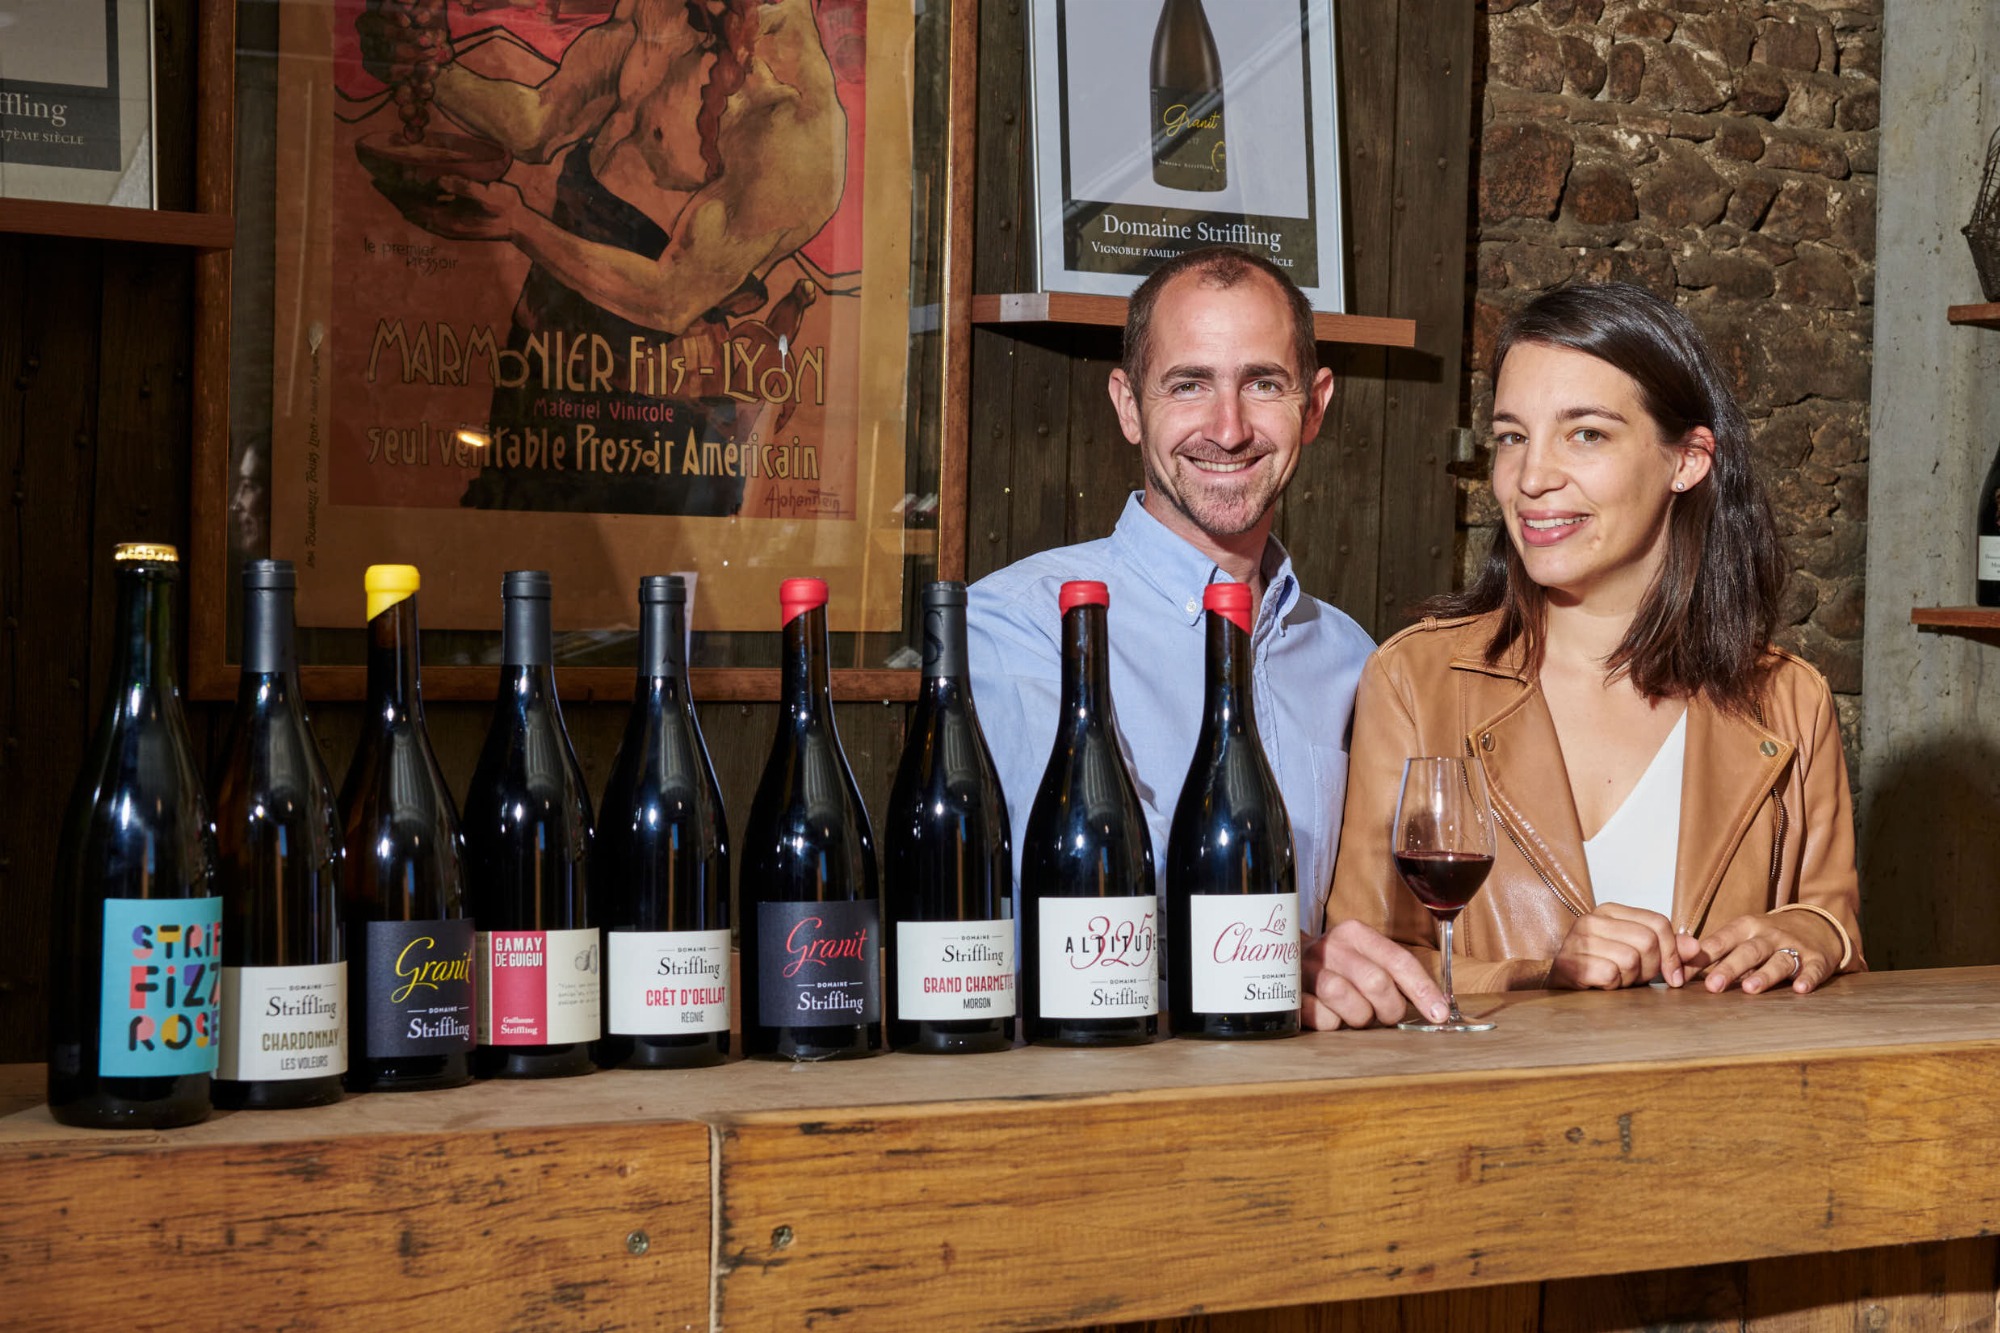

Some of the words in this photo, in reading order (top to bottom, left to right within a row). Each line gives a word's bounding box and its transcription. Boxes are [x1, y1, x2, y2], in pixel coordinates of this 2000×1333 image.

[1163, 104, 1221, 137] Granit
[42, 130, 84, 146] SIÈCLE
[1102, 214, 1191, 240] Domaine
[1197, 222, 1282, 252] Striffling
[364, 237, 376, 254] le
[382, 241, 438, 259] premier
[366, 318, 614, 394] MARMONIER
[630, 335, 686, 397] Fils
[723, 337, 824, 405] LYON
[608, 400, 674, 423] Vinicole
[367, 423, 429, 466] seul
[439, 425, 565, 471] véritable
[576, 424, 675, 475] Pressoir
[682, 428, 820, 480] Américain
[1259, 903, 1287, 936] Les
[495, 937, 543, 952] GAMAY
[783, 916, 868, 978] Granit
[1065, 933, 1157, 954] ALTITUDE
[1070, 912, 1155, 970] 325
[1213, 922, 1299, 964] Charmes
[495, 952, 508, 967] DE
[509, 952, 543, 967] GUIGUI
[942, 944, 1003, 966] Striffling
[391, 936, 473, 1003] Granit
[657, 957, 720, 979] Striffling
[646, 986, 676, 1007] CRÊT
[680, 985, 725, 1006] D'OEILLAT
[923, 976, 962, 994] GRAND
[1243, 982, 1297, 1004] Striffling
[265, 995, 337, 1019] Striffling
[797, 990, 864, 1014] Striffling
[963, 997, 991, 1010] MORGON
[1090, 987, 1149, 1010] Striffling
[428, 1006, 458, 1014] DOMAINE
[681, 1009, 704, 1024] RÉGNIÉ
[262, 1027, 340, 1053] CHARDONNAY
[407, 1016, 470, 1042] Striffling
[500, 1024, 538, 1035] Striffling
[280, 1057, 296, 1071] LES
[297, 1054, 329, 1070] VOLEURS
